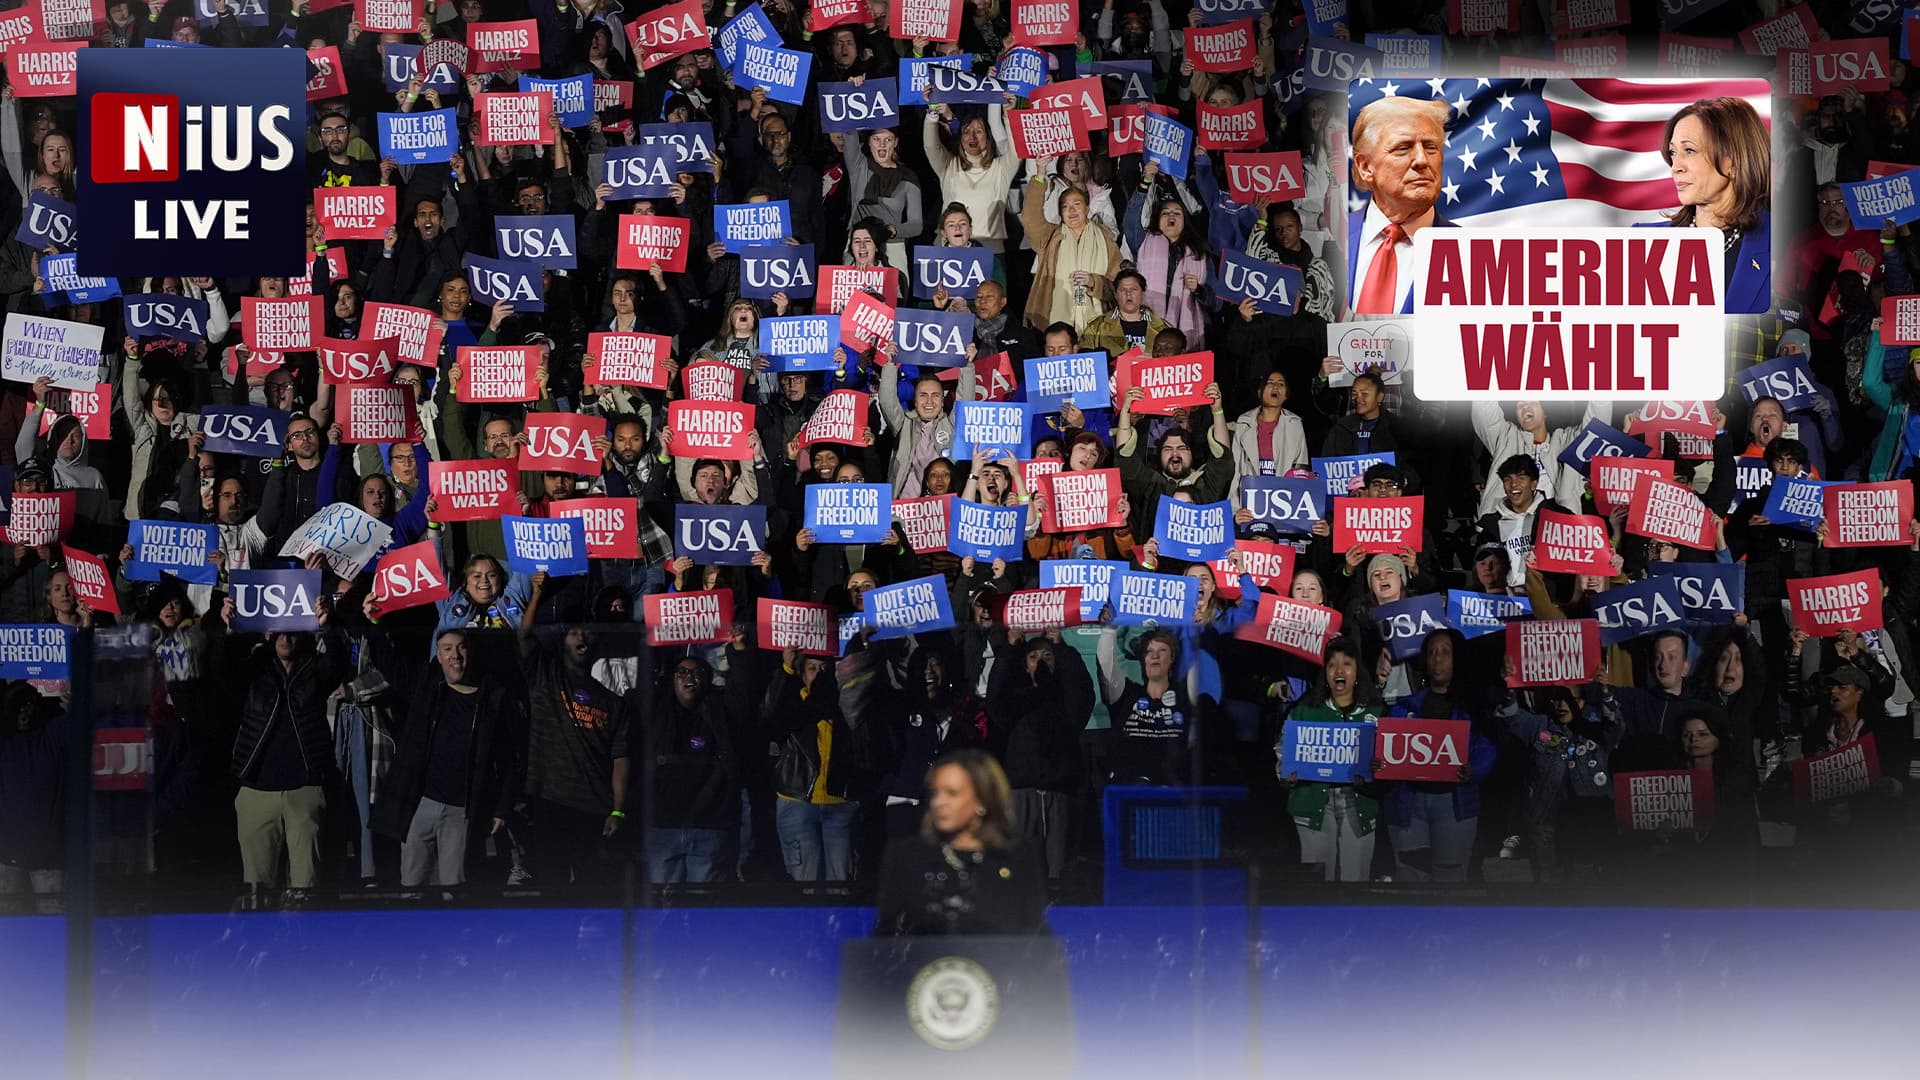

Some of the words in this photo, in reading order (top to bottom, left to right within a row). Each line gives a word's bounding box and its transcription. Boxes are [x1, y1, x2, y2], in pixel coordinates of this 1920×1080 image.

[42, 8, 93, 26] FREEDOM
[822, 2, 858, 18] WALZ
[902, 7, 950, 24] FREEDOM
[1018, 5, 1070, 24] HARRIS
[44, 22, 94, 39] FREEDOM
[366, 14, 412, 29] FREEDOM
[638, 13, 704, 47] USA
[901, 21, 947, 39] FREEDOM
[1025, 23, 1063, 36] WALZ
[475, 29, 529, 50] HARRIS
[1194, 29, 1247, 52] HARRIS
[482, 50, 521, 62] WALZ
[746, 44, 775, 64] VOTE
[776, 49, 799, 70] FOR
[1020, 52, 1041, 68] FOR
[1203, 50, 1242, 63] WALZ
[743, 60, 796, 88] FREEDOM
[1814, 51, 1886, 83] USA
[28, 73, 70, 85] WALZ
[562, 80, 583, 98] FOR
[487, 96, 539, 112] FREEDOM
[822, 91, 895, 121] USA
[389, 118, 420, 133] VOTE
[423, 115, 446, 131] FOR
[487, 112, 539, 127] FREEDOM
[1020, 111, 1069, 127] FREEDOM
[1201, 110, 1257, 130] HARRIS
[390, 130, 447, 149] FREEDOM
[488, 126, 540, 141] FREEDOM
[1023, 126, 1073, 142] FREEDOM
[1168, 123, 1185, 143] FOR
[1208, 131, 1249, 142] WALZ
[607, 157, 673, 187] USA
[1229, 164, 1300, 193] USA
[1854, 179, 1884, 202] VOTE
[1885, 175, 1910, 196] FOR
[324, 193, 384, 216] HARRIS
[1857, 190, 1915, 218] FREEDOM
[334, 216, 376, 228] WALZ
[727, 207, 756, 224] VOTE
[759, 206, 781, 223] FOR
[629, 224, 681, 248] HARRIS
[727, 221, 782, 240] FREEDOM
[499, 227, 573, 258] USA
[638, 247, 673, 260] WALZ
[471, 265, 540, 301] USA
[743, 258, 813, 288] USA
[832, 270, 884, 286] FREEDOM
[1224, 260, 1292, 307] USA
[127, 302, 202, 335] USA
[256, 301, 309, 317] FREEDOM
[376, 307, 431, 329] FREEDOM
[24, 321, 67, 343] WHEN
[256, 317, 310, 333] FREEDOM
[771, 322, 801, 338] VOTE
[803, 320, 828, 335] FOR
[256, 333, 310, 348] FREEDOM
[602, 336, 656, 353] FREEDOM
[771, 337, 828, 356] FREEDOM
[898, 321, 966, 355] USA
[1351, 339, 1393, 349] GRITTY
[8, 339, 55, 359] PHILLY
[470, 350, 525, 367] FREEDOM
[323, 349, 393, 380] USA
[601, 351, 654, 369] FREEDOM
[1037, 360, 1068, 379] VOTE
[1070, 358, 1095, 375] FOR
[470, 367, 525, 382] FREEDOM
[599, 366, 653, 384] FREEDOM
[689, 365, 735, 384] FREEDOM
[1141, 363, 1203, 388] HARRIS
[471, 382, 525, 398] FREEDOM
[1039, 374, 1097, 397] FREEDOM
[1150, 384, 1193, 399] WALZ
[350, 388, 404, 405] FREEDOM
[350, 405, 405, 422] FREEDOM
[677, 409, 743, 433] HARRIS
[964, 406, 996, 426] VOTE
[999, 406, 1022, 425] FOR
[203, 413, 281, 445] USA
[350, 422, 406, 438] FREEDOM
[805, 423, 854, 441] FREEDOM
[964, 425, 1022, 444] FREEDOM
[527, 425, 597, 462] USA
[687, 433, 732, 448] WALZ
[1325, 459, 1354, 479] VOTE
[441, 469, 508, 495] HARRIS
[1052, 473, 1107, 494] FREEDOM
[452, 494, 499, 509] WALZ
[817, 488, 849, 507] VOTE
[852, 488, 878, 507] FOR
[1054, 490, 1107, 510] FREEDOM
[1245, 488, 1321, 521] USA
[1650, 481, 1705, 511] FREEDOM
[1838, 491, 1898, 508] FREEDOM
[816, 507, 878, 526] FREEDOM
[961, 504, 994, 526] VOTE
[995, 510, 1017, 529] FOR
[1056, 507, 1108, 527] FREEDOM
[1170, 504, 1198, 526] VOTE
[1201, 507, 1224, 527] FOR
[1346, 507, 1412, 530] HARRIS
[1646, 498, 1702, 527] FREEDOM
[1839, 508, 1898, 525] FREEDOM
[143, 525, 176, 547] VOTE
[180, 528, 207, 547] FOR
[512, 521, 542, 541] VOTE
[544, 522, 571, 541] FOR
[680, 518, 762, 552] USA
[958, 524, 1016, 546] FREEDOM
[1167, 522, 1225, 544] FREEDOM
[1356, 530, 1402, 543] WALZ
[1541, 521, 1604, 549] HARRIS
[1642, 516, 1700, 544] FREEDOM
[1839, 525, 1899, 542] FREEDOM
[514, 541, 573, 560] FREEDOM
[1508, 535, 1530, 549] HARR
[140, 546, 205, 567] FREEDOM
[1548, 547, 1594, 563] WALZ
[1054, 565, 1087, 584] VOTE
[874, 591, 907, 612] VOTE
[909, 583, 935, 604] FOR
[1122, 576, 1156, 596] VOTE
[1158, 580, 1186, 600] FOR
[1801, 581, 1869, 611] HARRIS
[233, 583, 316, 617] USA
[660, 595, 719, 616] FREEDOM
[1119, 594, 1184, 619] FREEDOM
[876, 602, 939, 629] FREEDOM
[1007, 605, 1065, 624] FREEDOM
[1814, 607, 1862, 625] WALZ
[38, 629, 66, 645] FOR
[1297, 727, 1330, 746] VOTE
[1333, 728, 1360, 745] FOR
[1295, 744, 1359, 764] FREEDOM
[1381, 732, 1463, 766] USA
[1629, 775, 1692, 795] FREEDOM
[1631, 793, 1693, 813] FREEDOM
